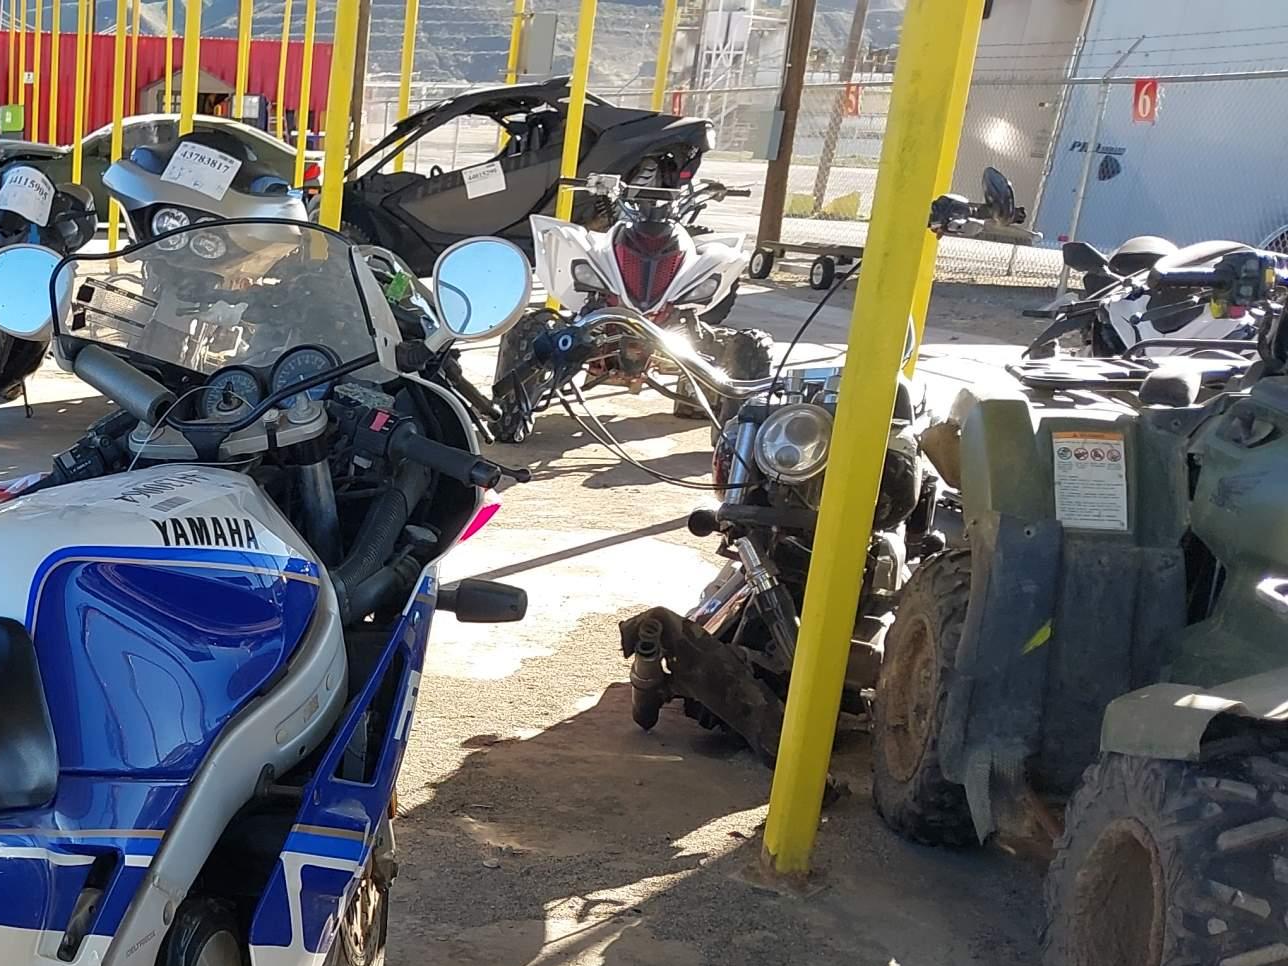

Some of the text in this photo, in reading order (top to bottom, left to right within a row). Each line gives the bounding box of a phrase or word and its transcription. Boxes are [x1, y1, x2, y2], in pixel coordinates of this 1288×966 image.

[1138, 82, 1151, 118] 6
[180, 150, 230, 174] 43783817
[150, 517, 260, 550] YAMAHA
